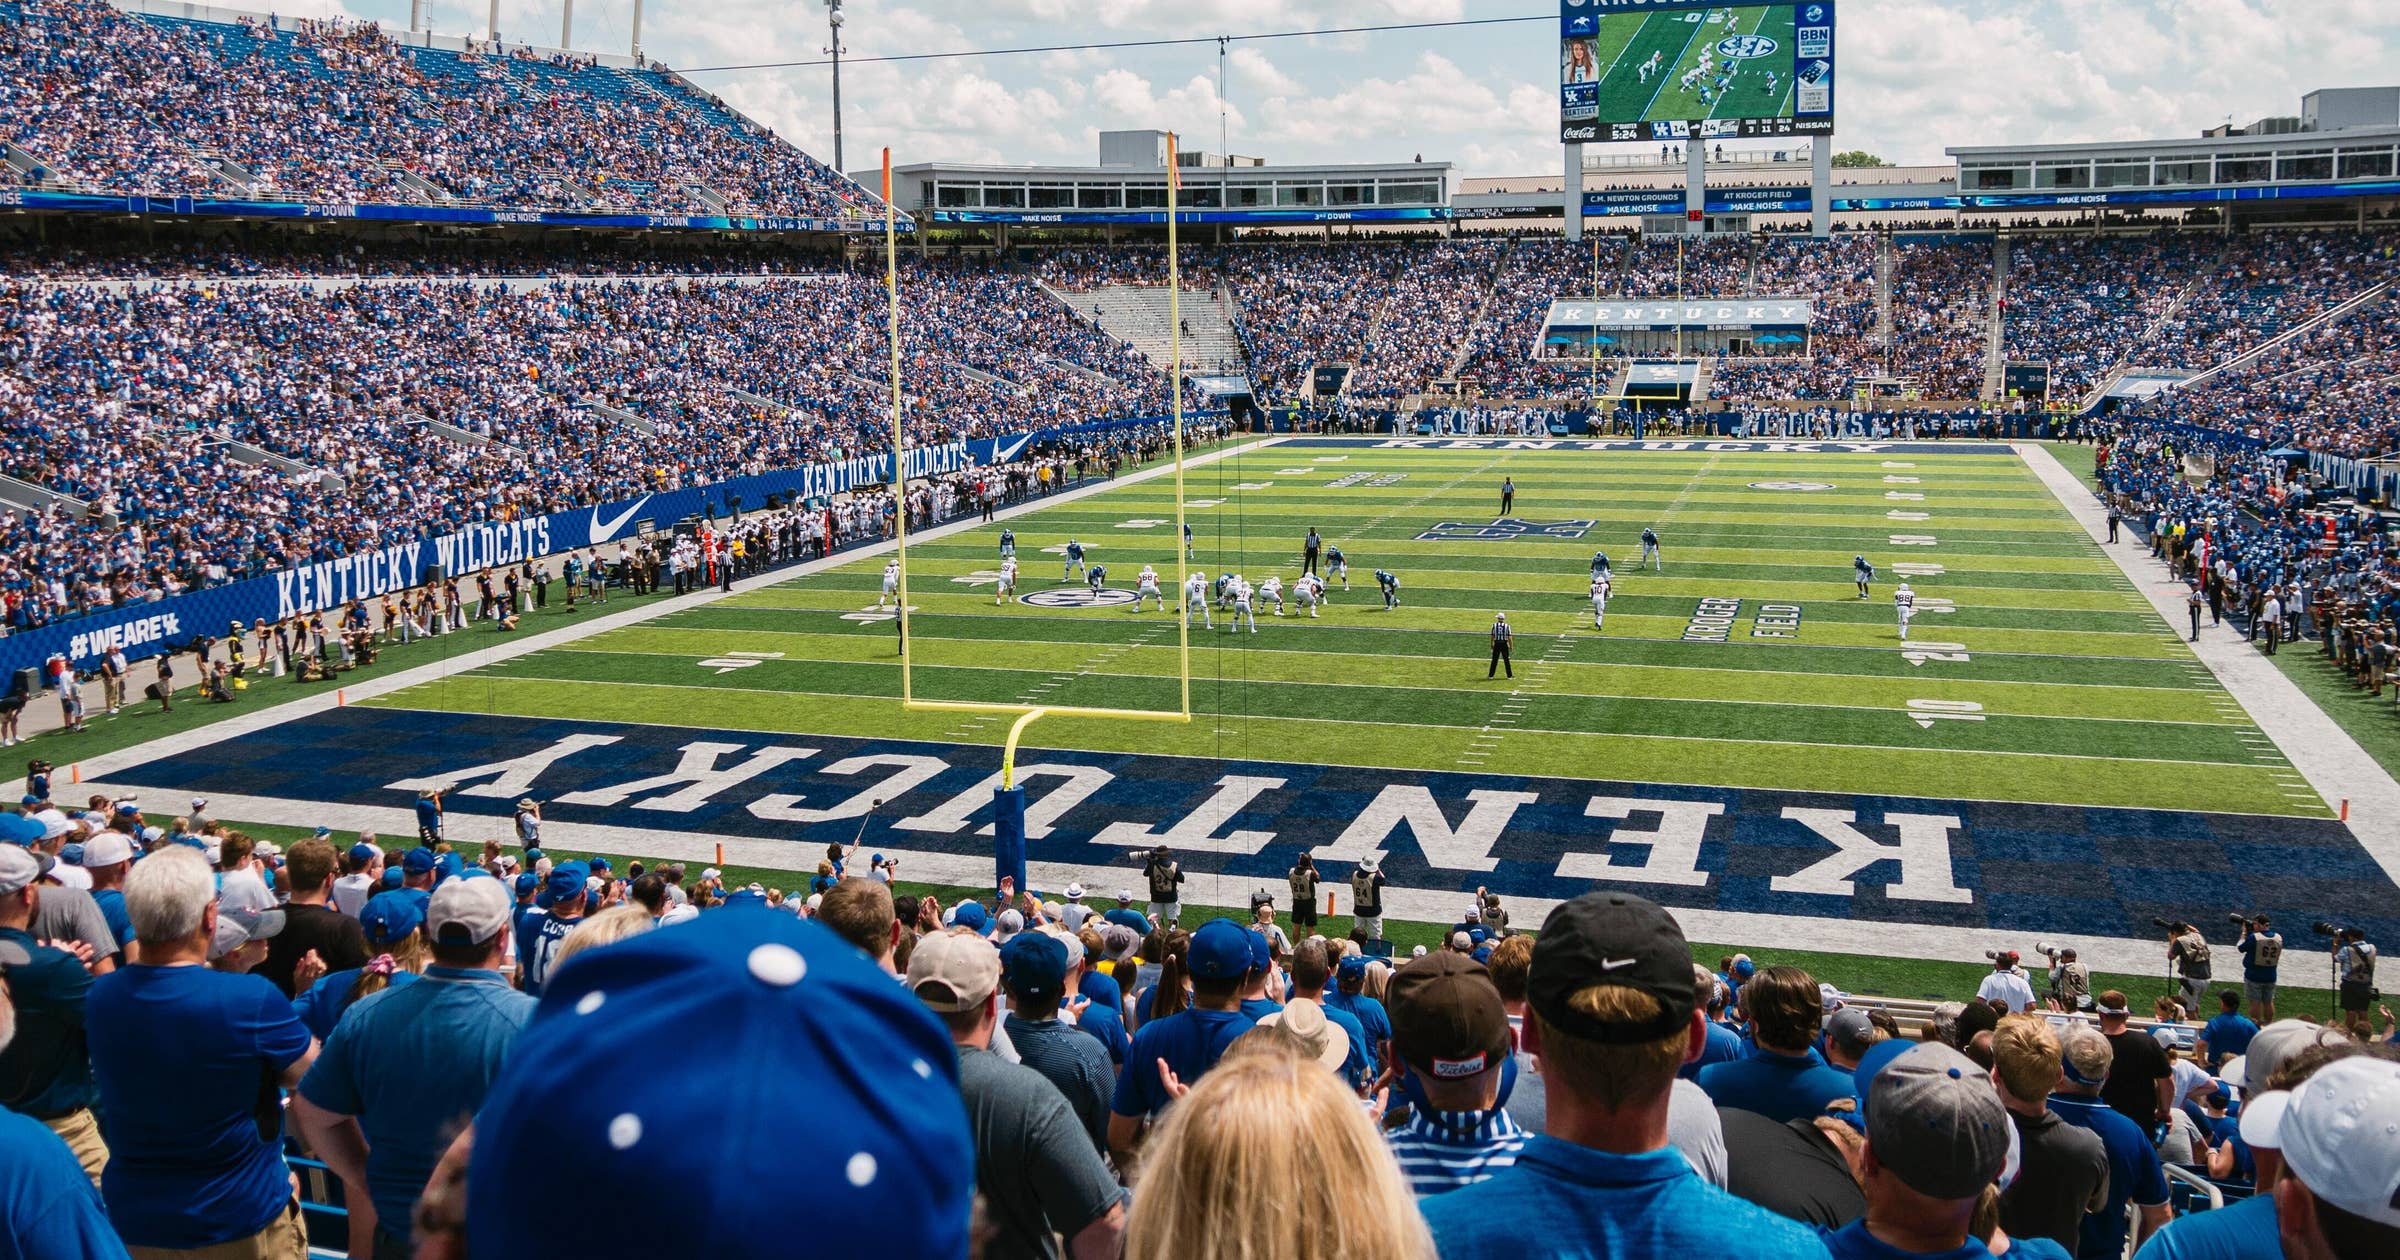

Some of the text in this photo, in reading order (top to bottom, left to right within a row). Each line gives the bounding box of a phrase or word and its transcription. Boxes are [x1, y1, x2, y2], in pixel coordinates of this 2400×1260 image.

[1801, 29, 1828, 40] BBN
[1612, 130, 1637, 139] 5:24
[0, 192, 23, 205] ISE
[1641, 193, 1679, 201] GROUNDS
[1723, 190, 1792, 200] AT KROGER FIELD
[2057, 194, 2107, 204] MAKE NOISE
[1607, 204, 1658, 213] MAKE NOISE
[1903, 200, 1930, 208] DOWN
[304, 205, 356, 217] 3RD DOWN
[1327, 212, 1351, 220] DOWN
[1688, 210, 1702, 221] 35
[495, 213, 542, 222] MAKE NOISE
[649, 217, 689, 226] 3RD DOWN
[1041, 214, 1063, 222] NOISE
[767, 221, 777, 230] 14
[797, 221, 807, 229] 14
[823, 221, 840, 230] 5:24
[867, 222, 881, 231] 3RD
[905, 223, 915, 231] 24
[1563, 307, 1797, 320] KENTUCKY
[1373, 440, 1893, 452] KENTUCKY
[803, 453, 888, 498] KENTUCKY
[277, 515, 550, 620] KENTUCKY WILDCATS
[1194, 583, 1200, 593] 6
[1593, 585, 1603, 594] 10
[1898, 594, 1912, 602] 88
[1681, 597, 1743, 642] KROGER
[1750, 604, 1802, 638] FIELD
[1900, 641, 1970, 662] 20
[1906, 699, 1986, 721] 10
[383, 733, 1974, 905] KENTUCKY
[1355, 887, 1368, 899] 64
[2262, 945, 2278, 958] 62
